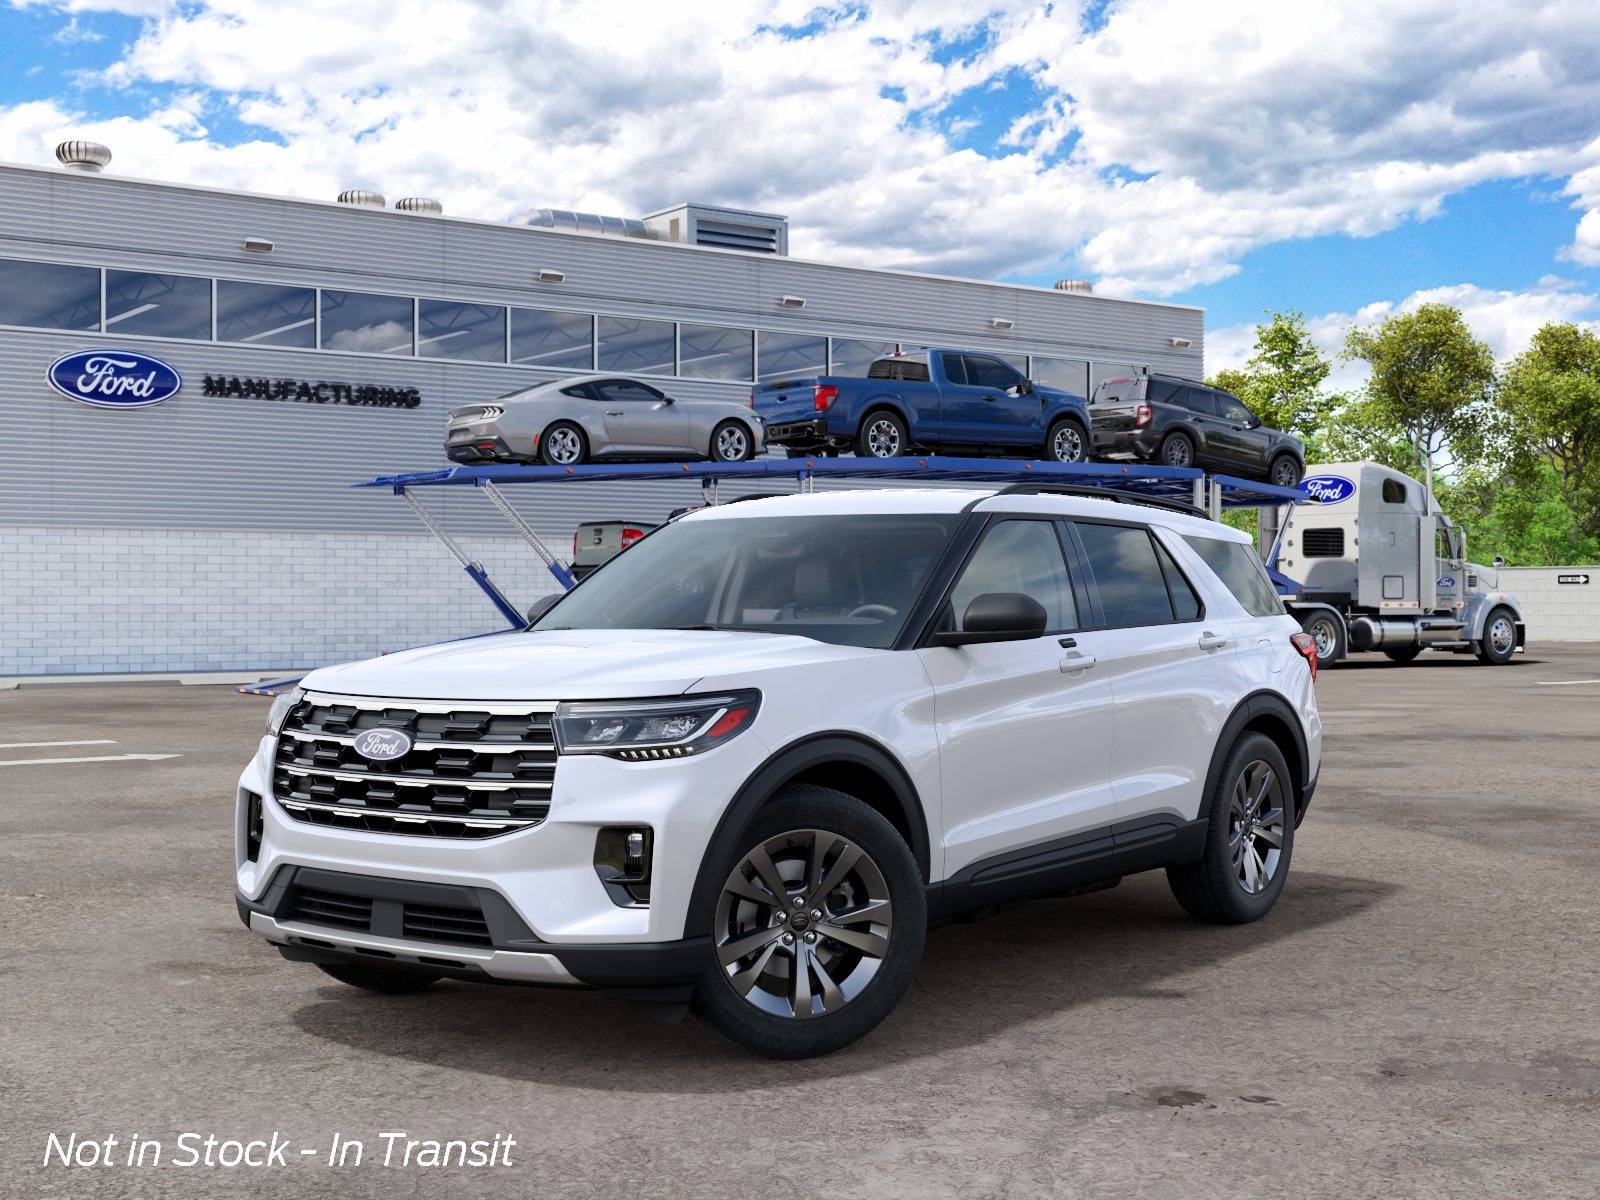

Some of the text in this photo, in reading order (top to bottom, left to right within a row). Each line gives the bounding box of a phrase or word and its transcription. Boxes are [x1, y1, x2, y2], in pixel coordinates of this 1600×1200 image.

[76, 356, 157, 398] Ford
[204, 374, 421, 409] MANUFACTURING
[1306, 479, 1343, 500] Ford
[361, 732, 401, 756] Ford
